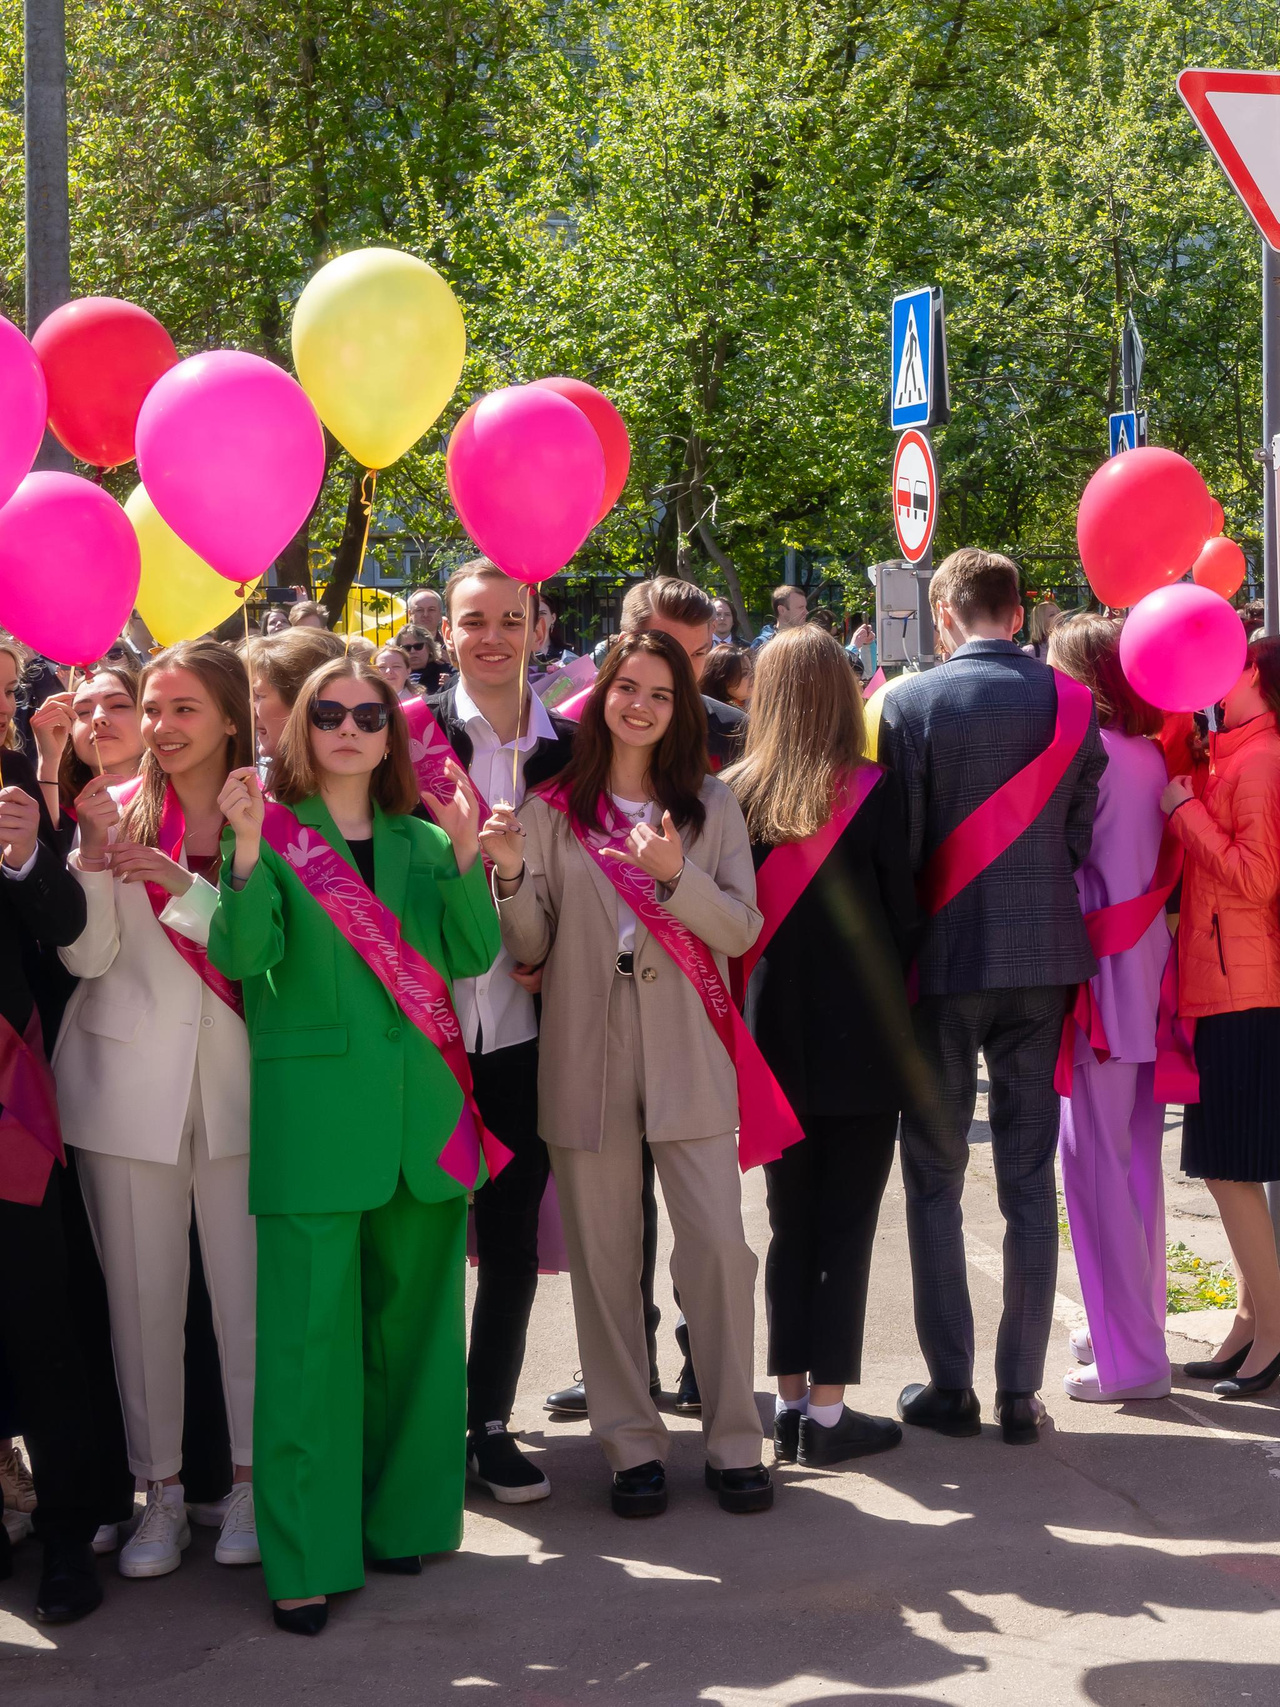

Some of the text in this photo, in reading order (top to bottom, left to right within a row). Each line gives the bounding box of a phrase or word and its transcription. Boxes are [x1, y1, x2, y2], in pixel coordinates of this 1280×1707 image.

[322, 876, 459, 1042] Выпускница 2022
[702, 974, 729, 1018] 2022
